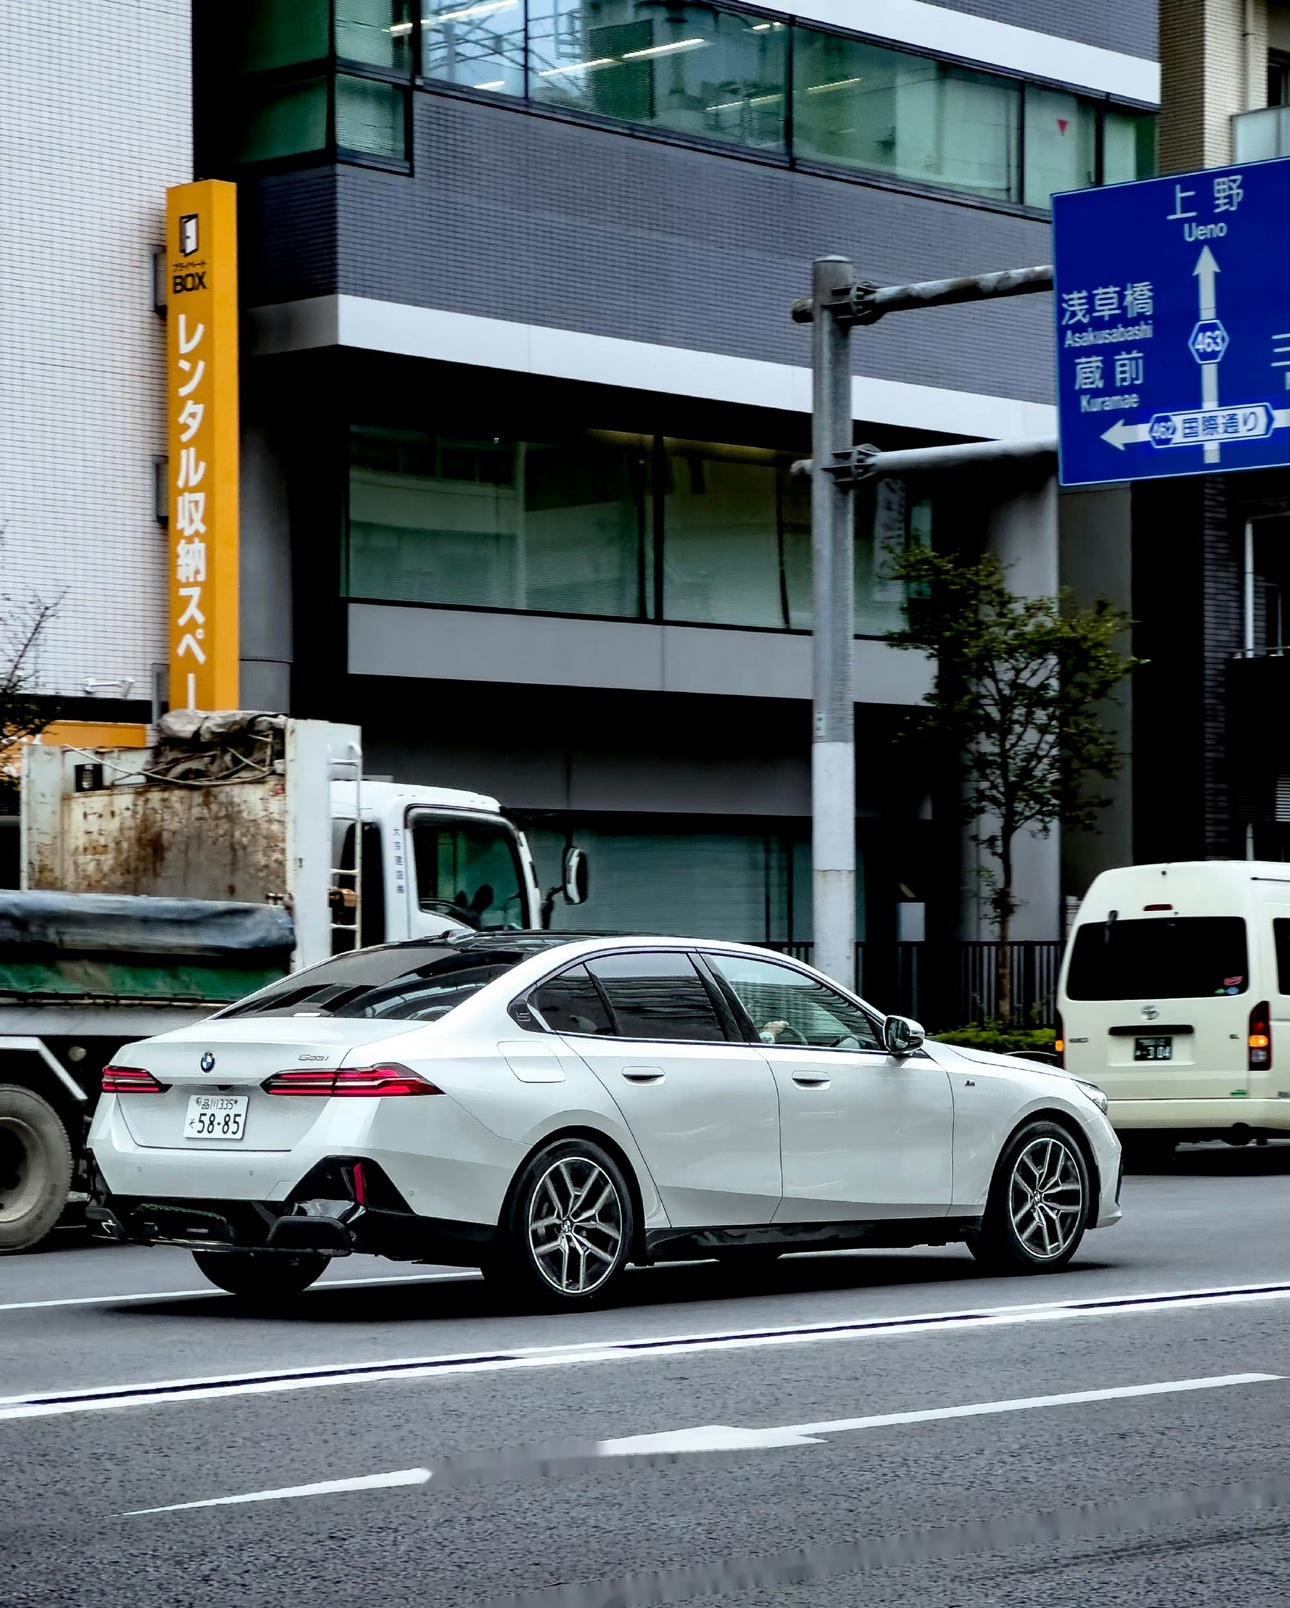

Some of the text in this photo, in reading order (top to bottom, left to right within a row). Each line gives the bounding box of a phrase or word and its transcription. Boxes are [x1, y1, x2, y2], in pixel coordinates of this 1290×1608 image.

[1166, 174, 1244, 221] 上野
[1183, 222, 1228, 242] Ueno
[173, 272, 207, 294] BOX
[1061, 281, 1154, 326] 浅草橋
[1064, 320, 1154, 348] Asakusabashi
[1194, 330, 1224, 353] 463
[1074, 350, 1145, 389] 蔵前
[1080, 393, 1139, 413] Kuramae
[1182, 411, 1259, 439] 国際通り
